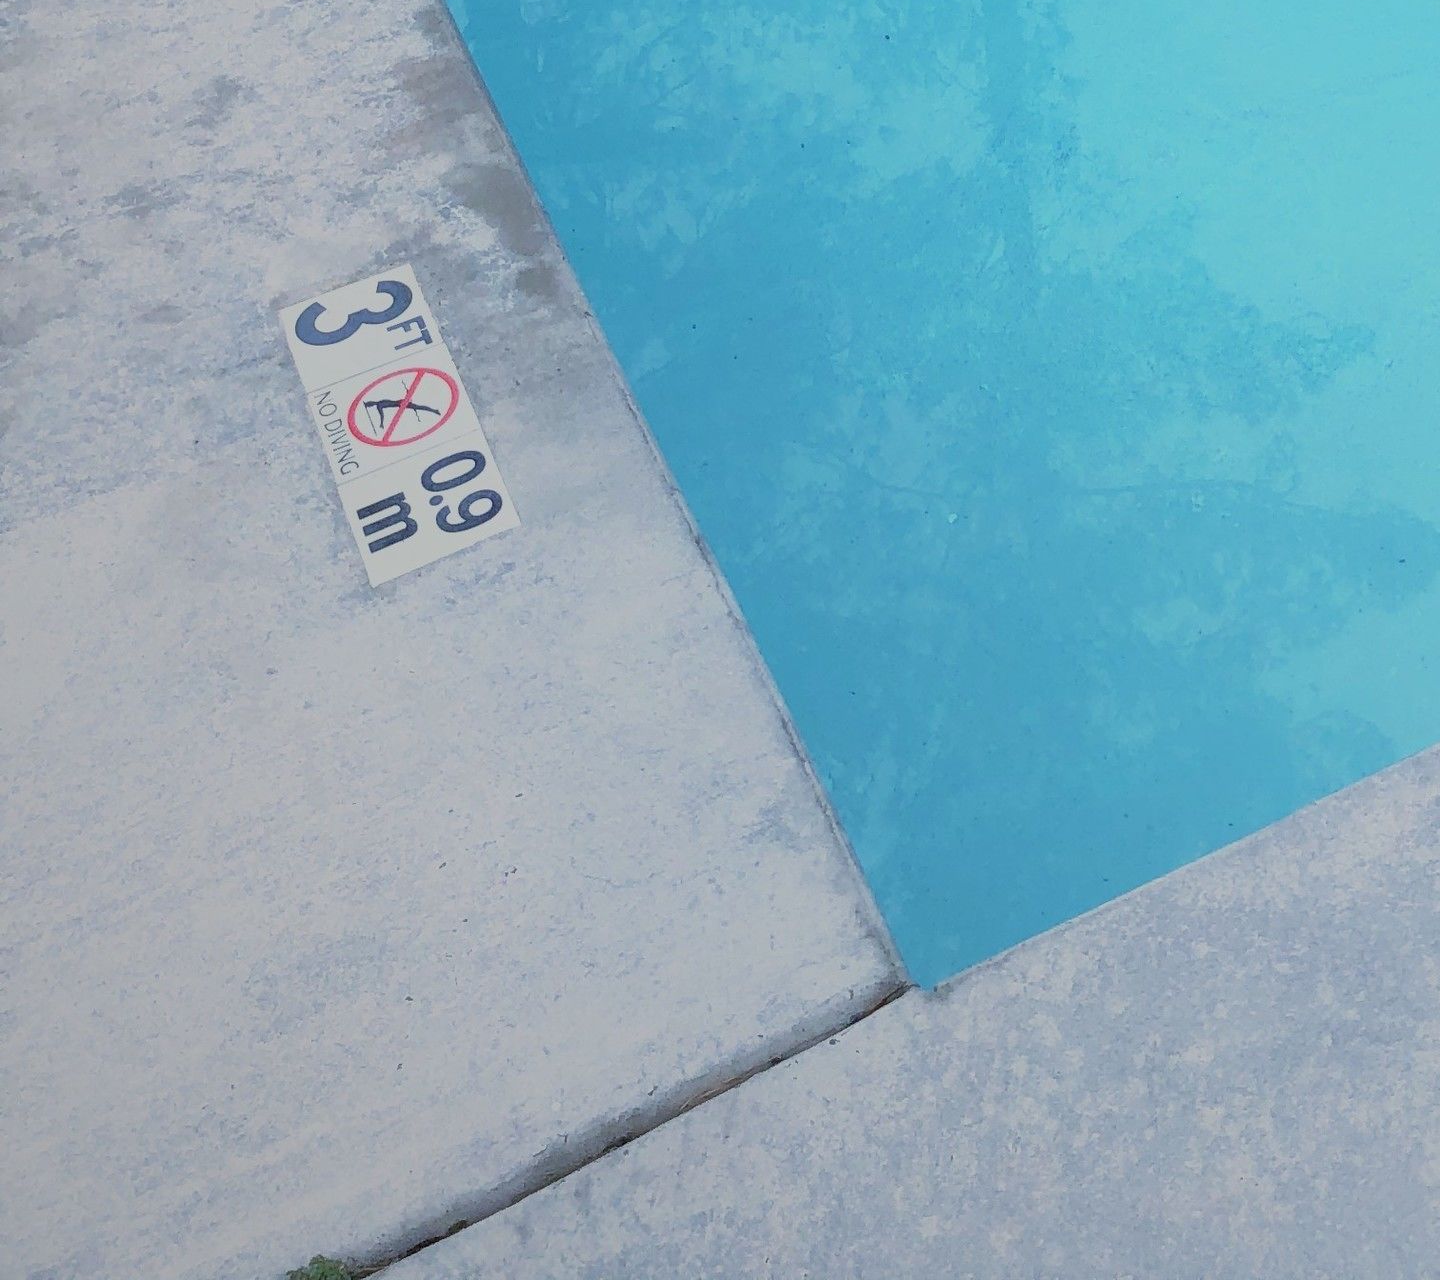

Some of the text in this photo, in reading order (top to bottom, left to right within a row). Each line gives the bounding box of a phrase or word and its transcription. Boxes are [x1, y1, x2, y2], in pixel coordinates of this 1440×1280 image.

[294, 279, 433, 352] 3 FT
[314, 390, 360, 476] NO DIVING
[356, 491, 419, 554] m
[420, 449, 504, 534] 0.9
